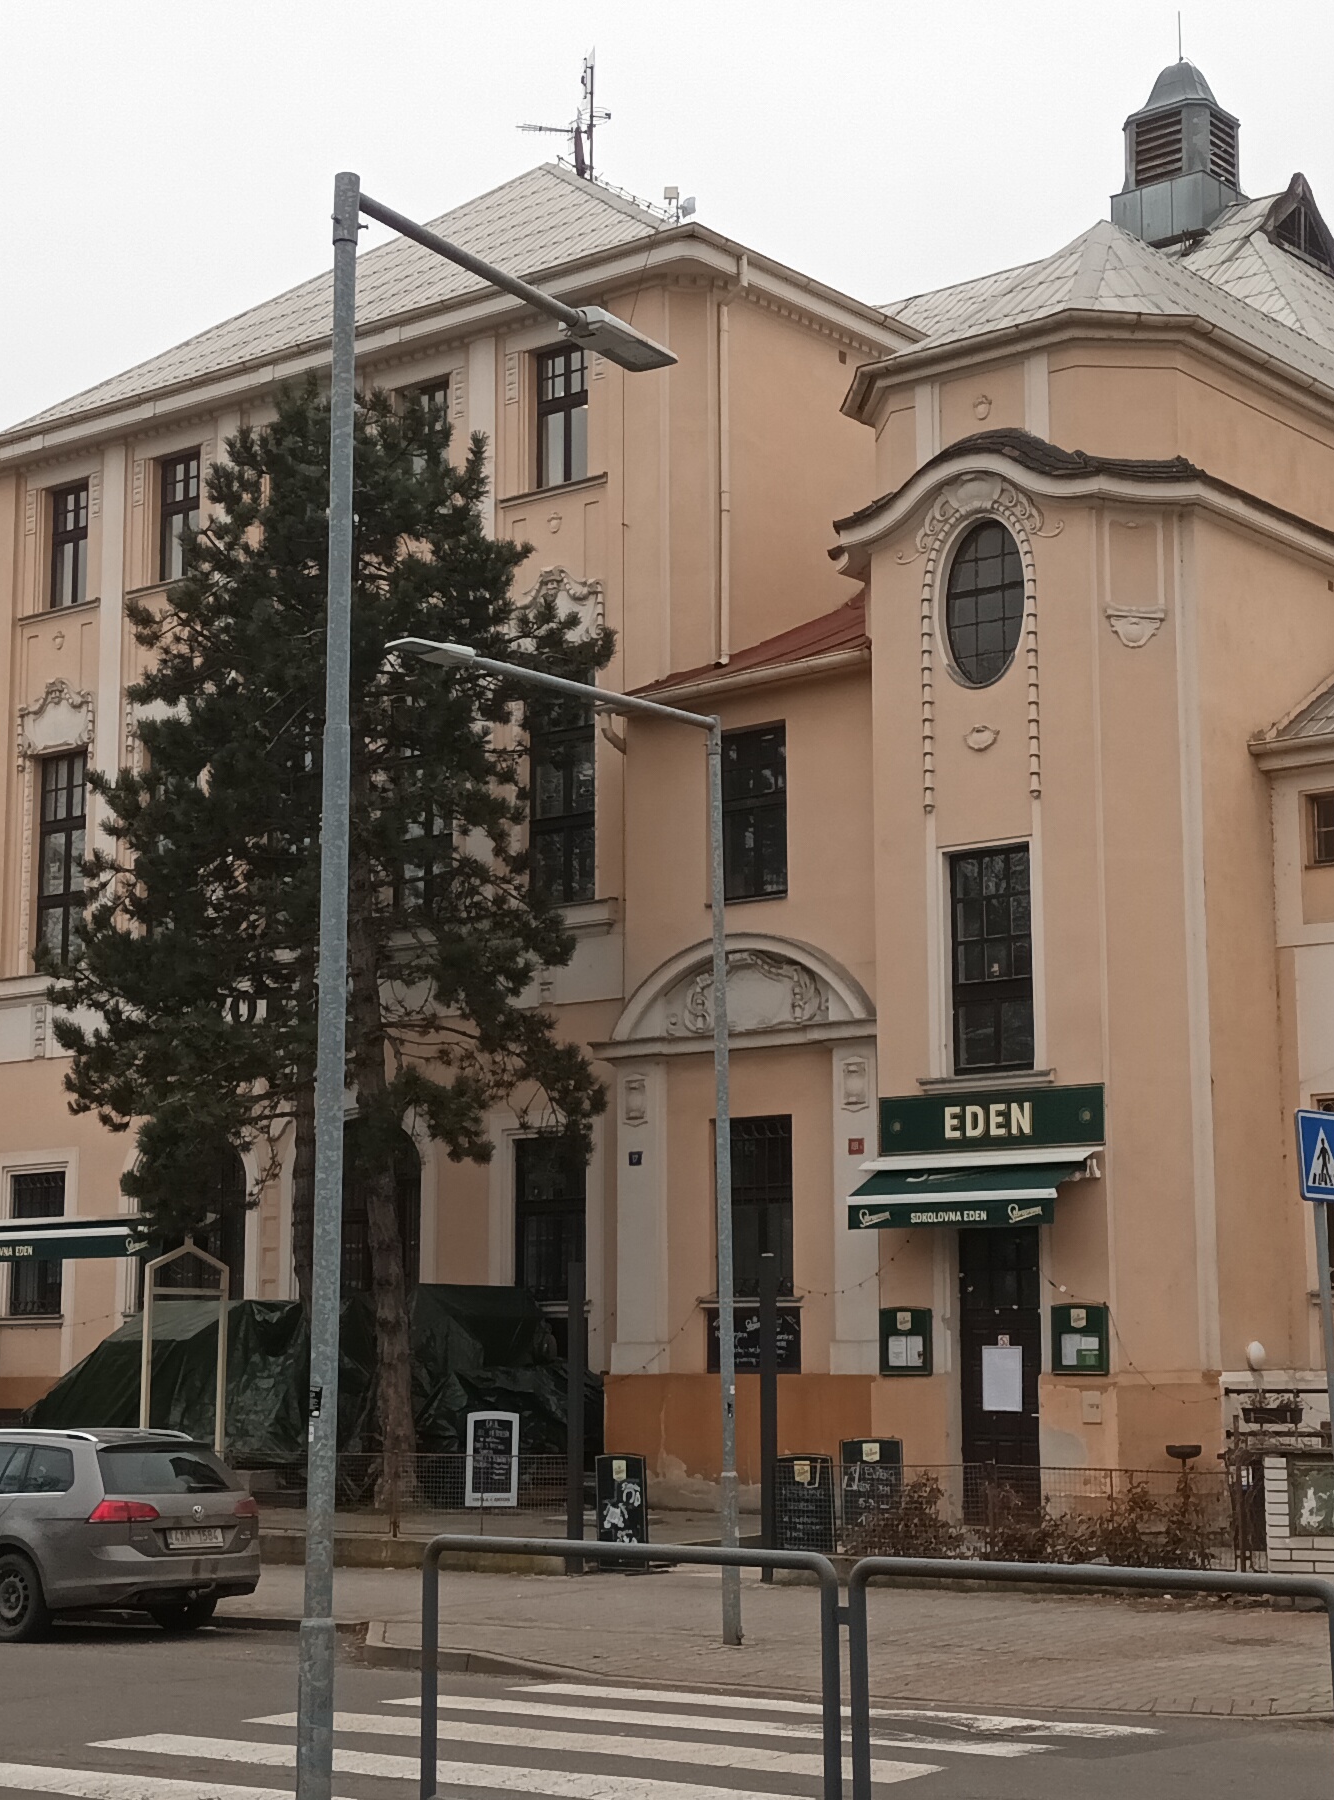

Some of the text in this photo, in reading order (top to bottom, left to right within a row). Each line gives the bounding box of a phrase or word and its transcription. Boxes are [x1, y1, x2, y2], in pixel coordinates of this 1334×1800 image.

[945, 1102, 1033, 1139] EDEN
[910, 1210, 987, 1223] SOKOLOVNA EDEN
[15, 1245, 33, 1256] EDEN
